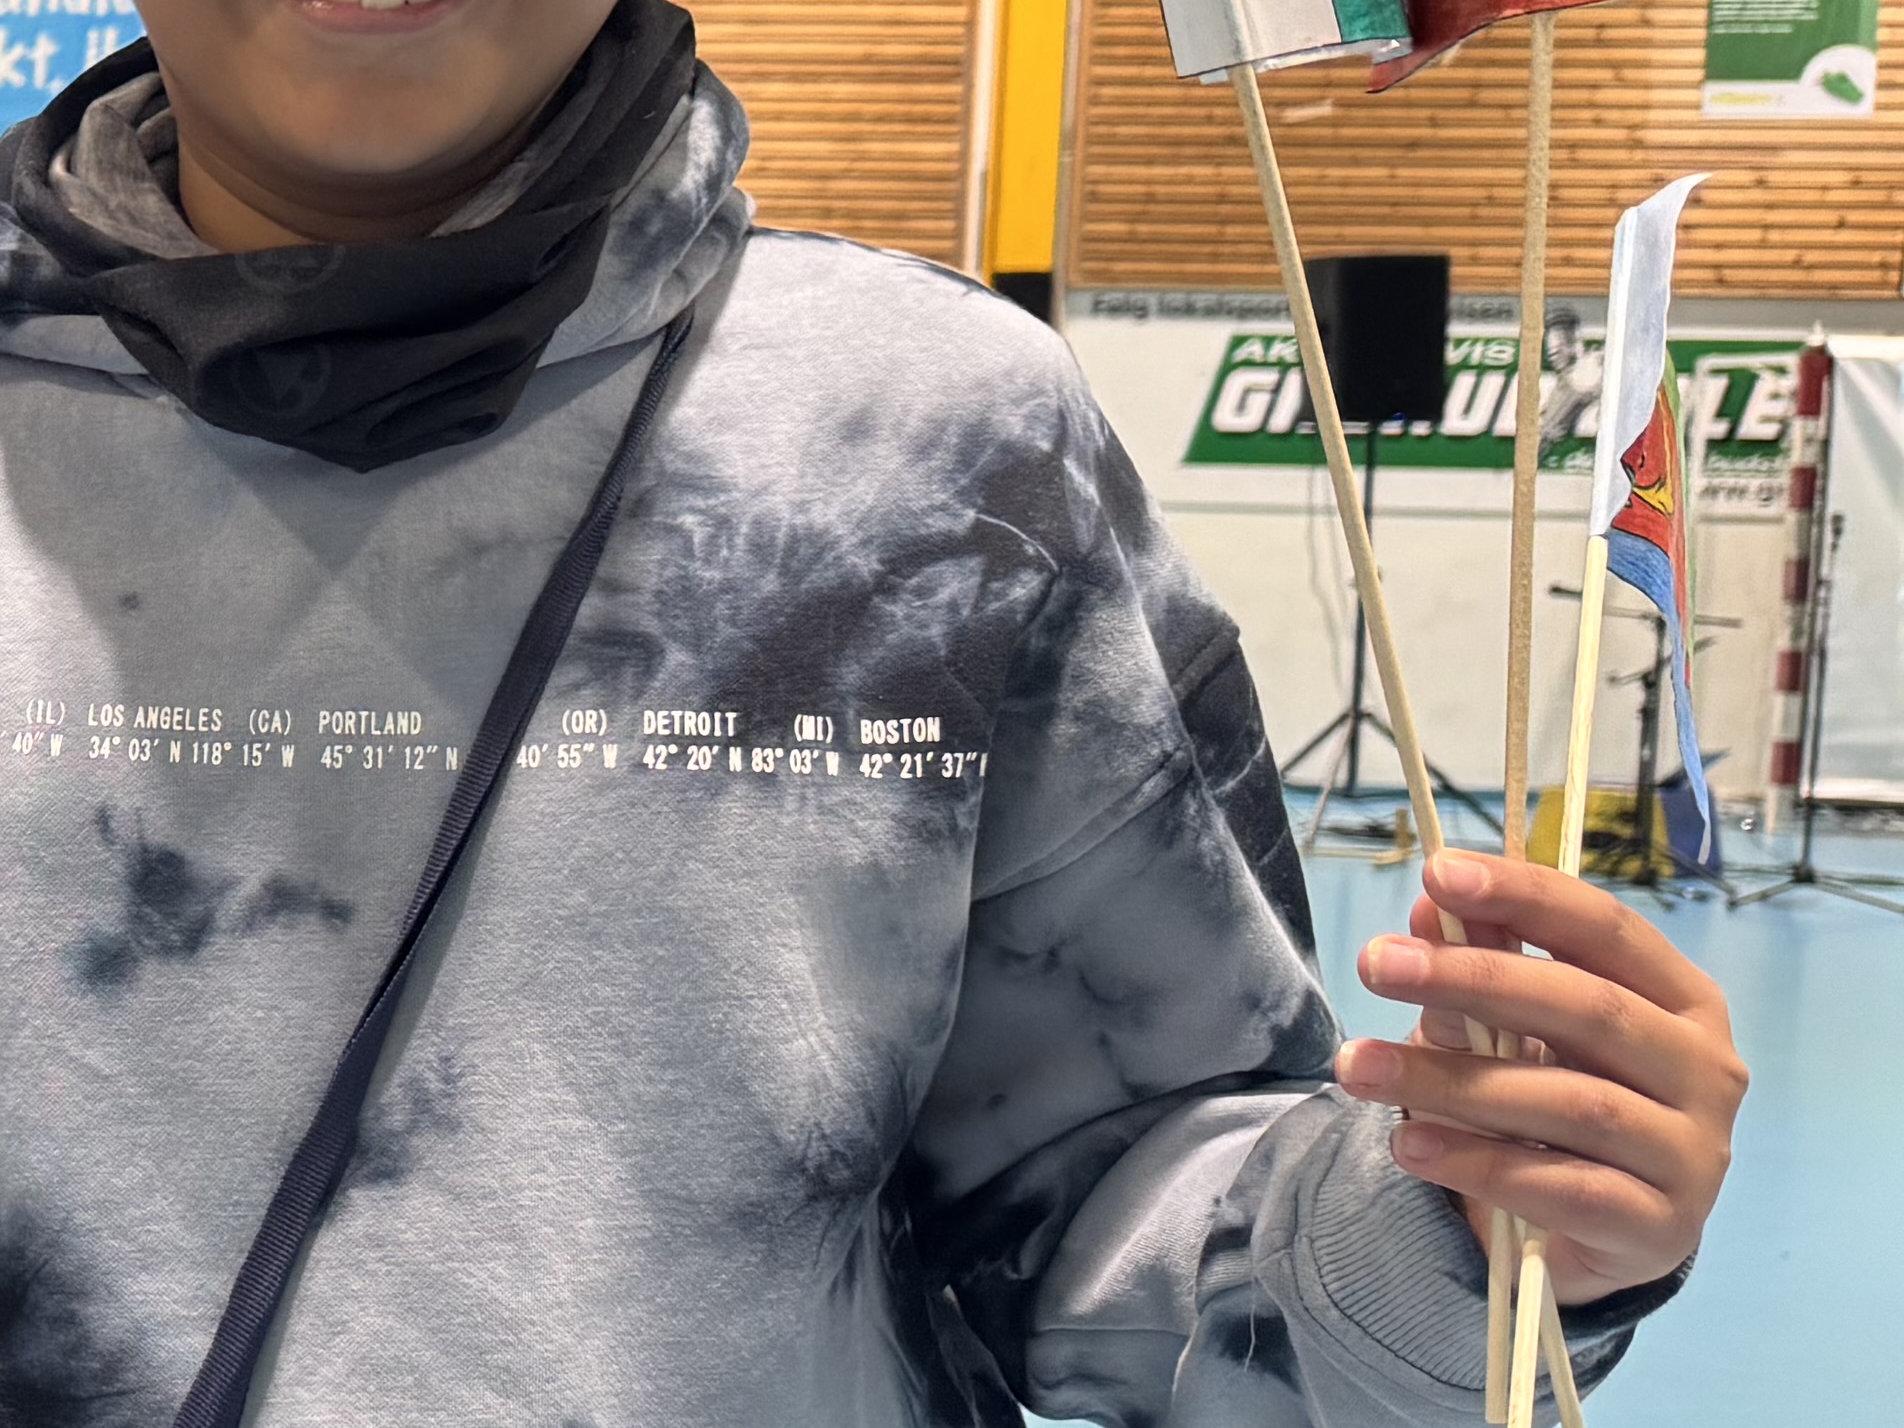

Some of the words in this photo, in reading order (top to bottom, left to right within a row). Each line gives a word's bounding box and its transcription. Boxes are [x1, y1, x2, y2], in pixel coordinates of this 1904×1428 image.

[26, 699, 66, 725] (IL)
[88, 703, 125, 727] LOS
[134, 706, 223, 732] ANGELES
[249, 709, 291, 735] (CA)
[318, 710, 422, 735] PORTLAND
[562, 709, 607, 736] (OR)
[643, 710, 738, 737] DETROIT
[794, 714, 833, 743] (MI)
[860, 716, 941, 744] BOSTON
[50, 733, 64, 756] W
[89, 736, 121, 759] 34°
[169, 740, 181, 763] N
[193, 741, 232, 765] 118°
[281, 744, 295, 768] W
[321, 744, 353, 769] 45°
[446, 747, 458, 771] N
[602, 744, 618, 769] W
[729, 746, 742, 772] N
[826, 751, 840, 776] W
